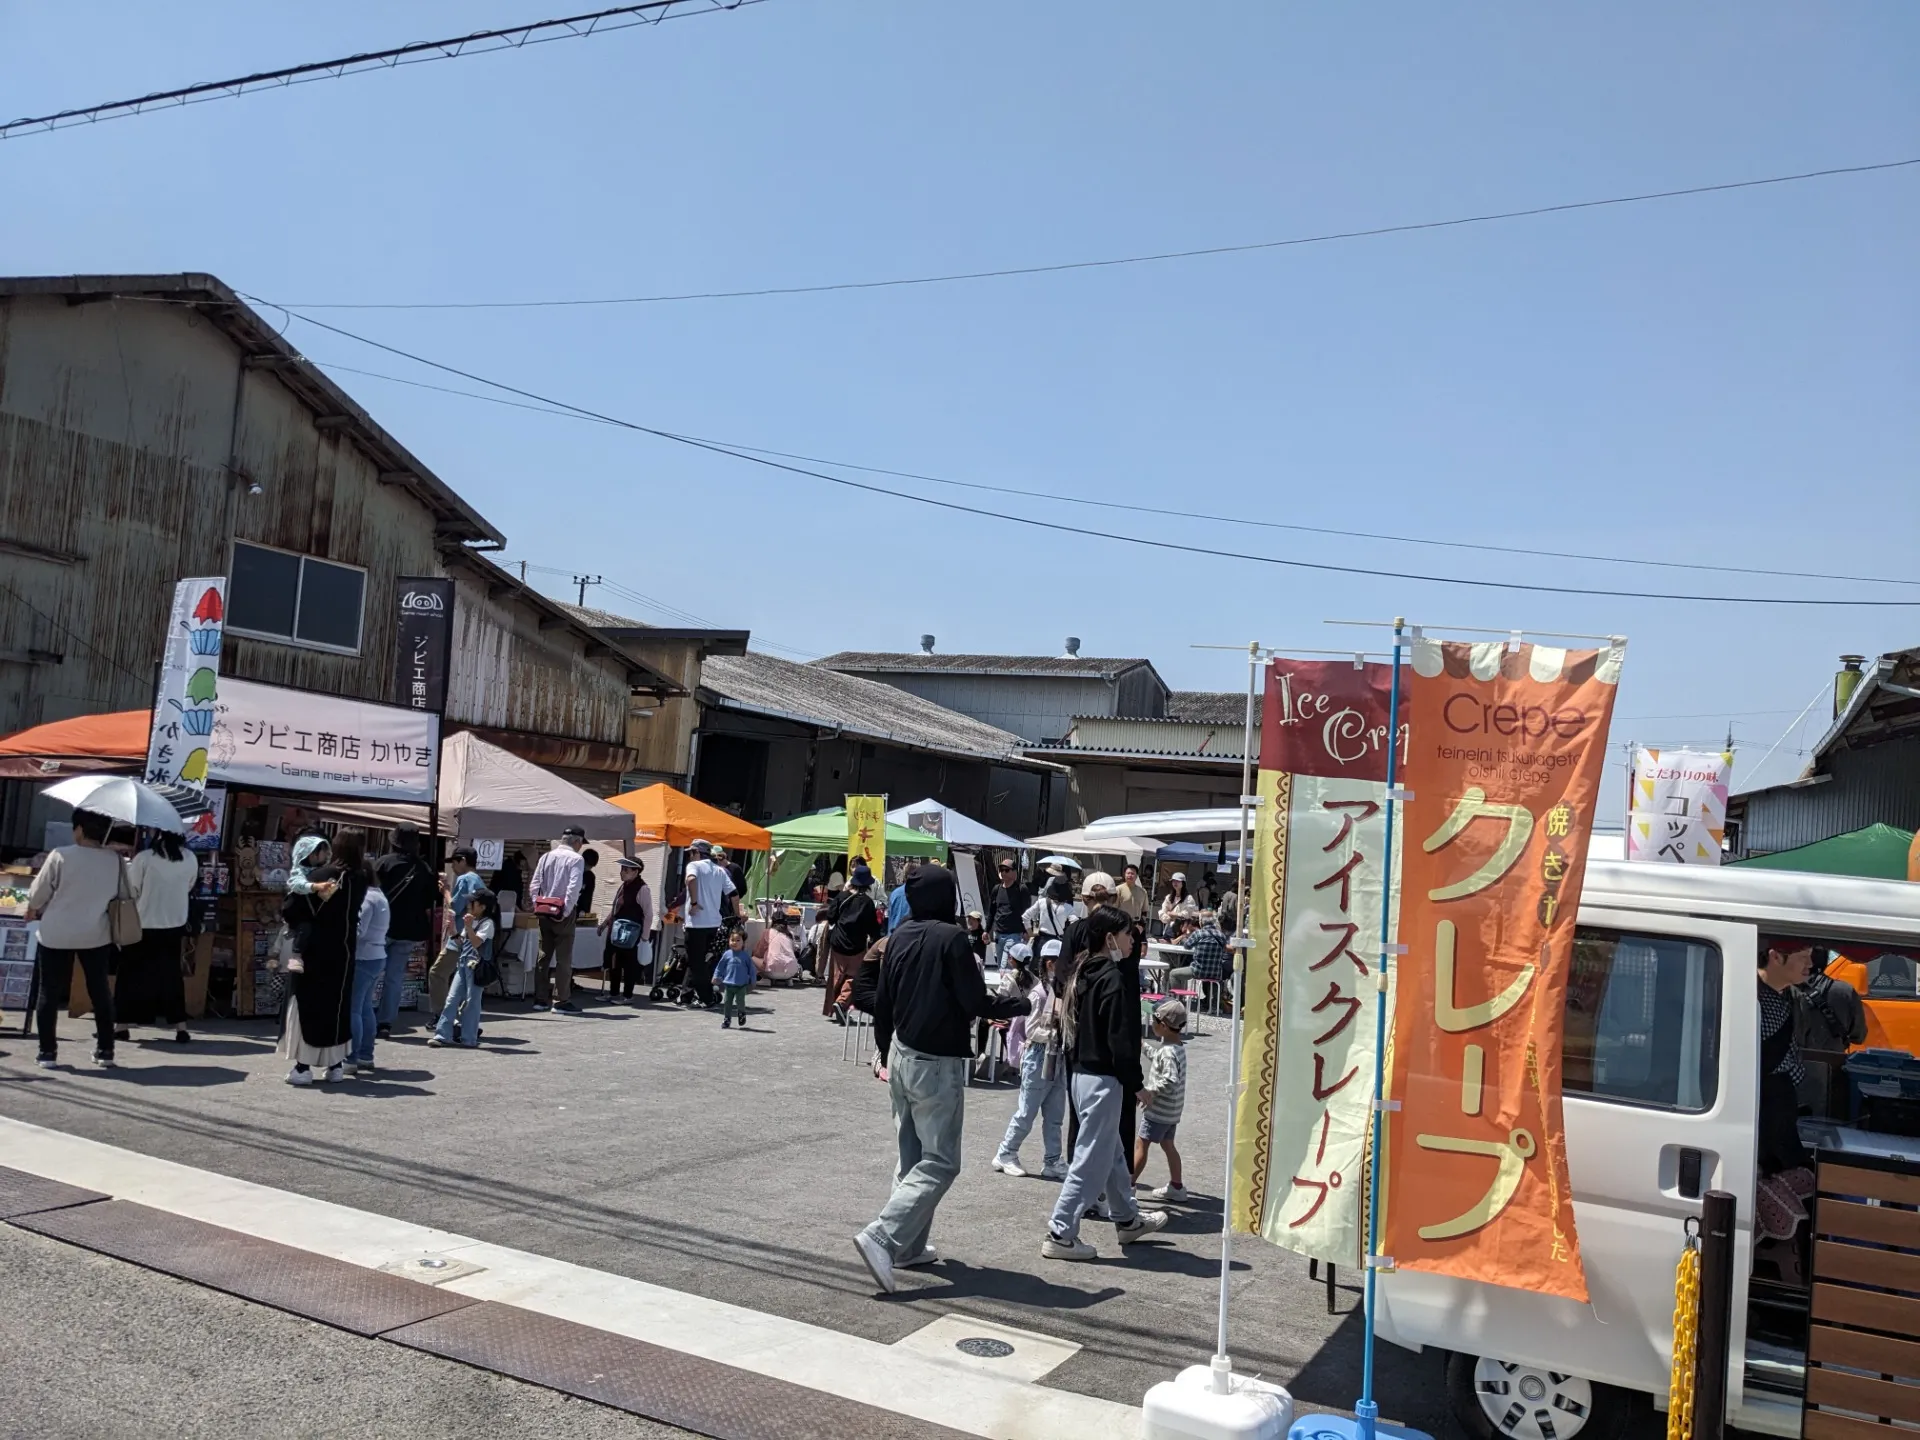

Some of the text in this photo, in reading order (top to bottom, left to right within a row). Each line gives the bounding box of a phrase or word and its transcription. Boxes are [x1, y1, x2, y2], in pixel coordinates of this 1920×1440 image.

[1275, 672, 1330, 727] Ice
[1443, 692, 1586, 746] Crepe
[243, 720, 432, 768] ジビエ商店 かやき
[281, 762, 395, 790] Game meat shop
[1645, 768, 1719, 783] こだわりの味
[1657, 796, 1690, 864] コッペ
[1288, 800, 1380, 1229] アイスクレープ
[1416, 787, 1536, 1240] クレープ
